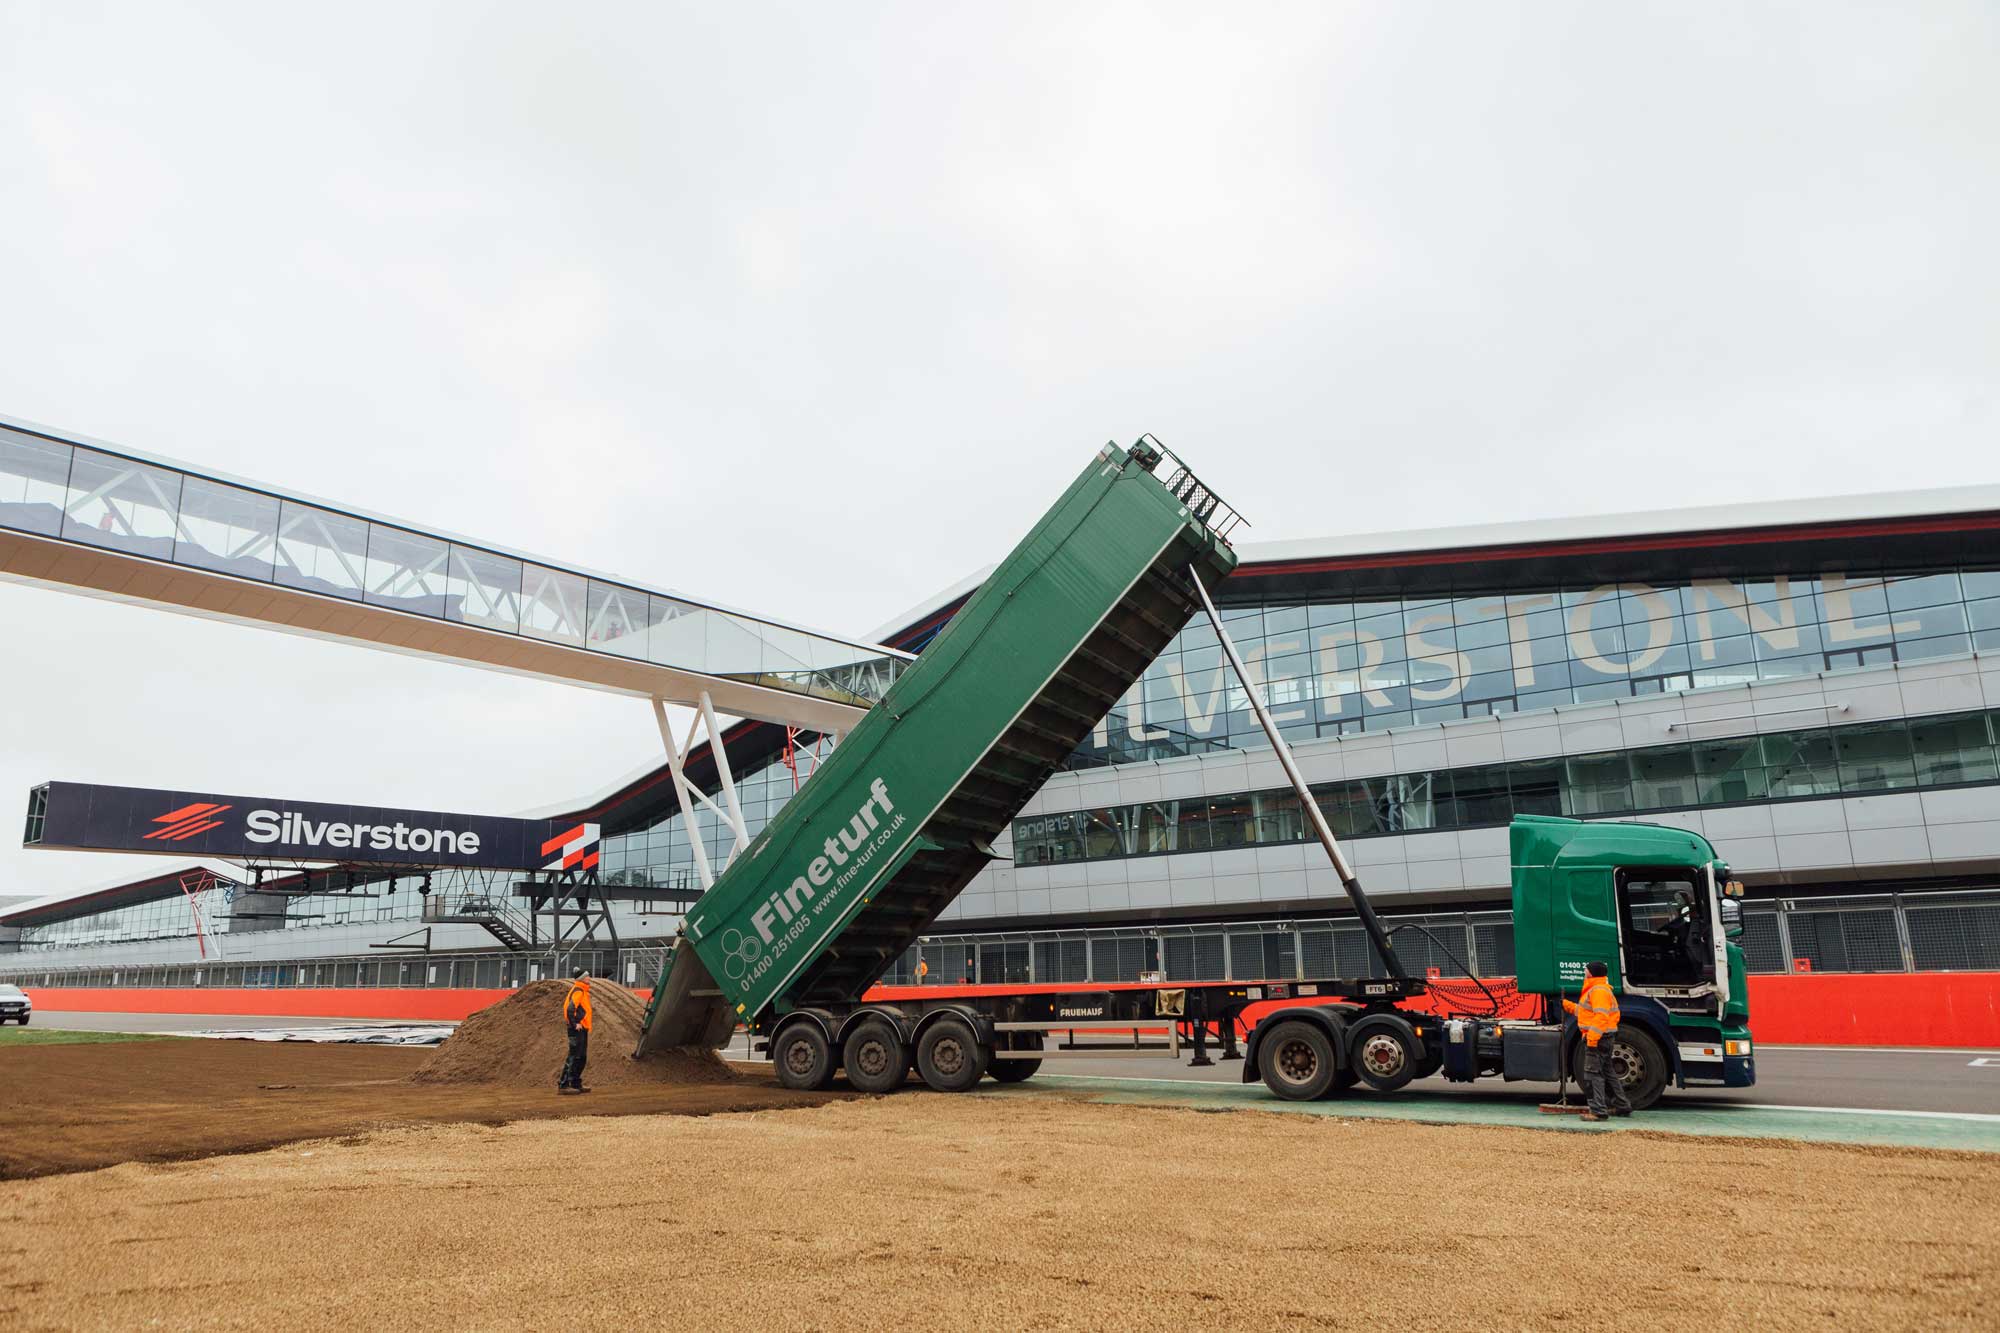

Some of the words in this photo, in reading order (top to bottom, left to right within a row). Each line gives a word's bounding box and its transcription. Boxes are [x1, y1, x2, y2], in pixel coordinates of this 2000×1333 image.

[1093, 573, 1921, 748] LVERSTONE
[245, 810, 480, 854] Silverstone
[741, 955, 773, 991] 01400
[772, 914, 811, 959] 251605
[812, 813, 907, 915] www.fine-turf.co.uk
[751, 777, 894, 945] Fineturf
[1060, 1007, 1103, 1017] FRUEHAUF
